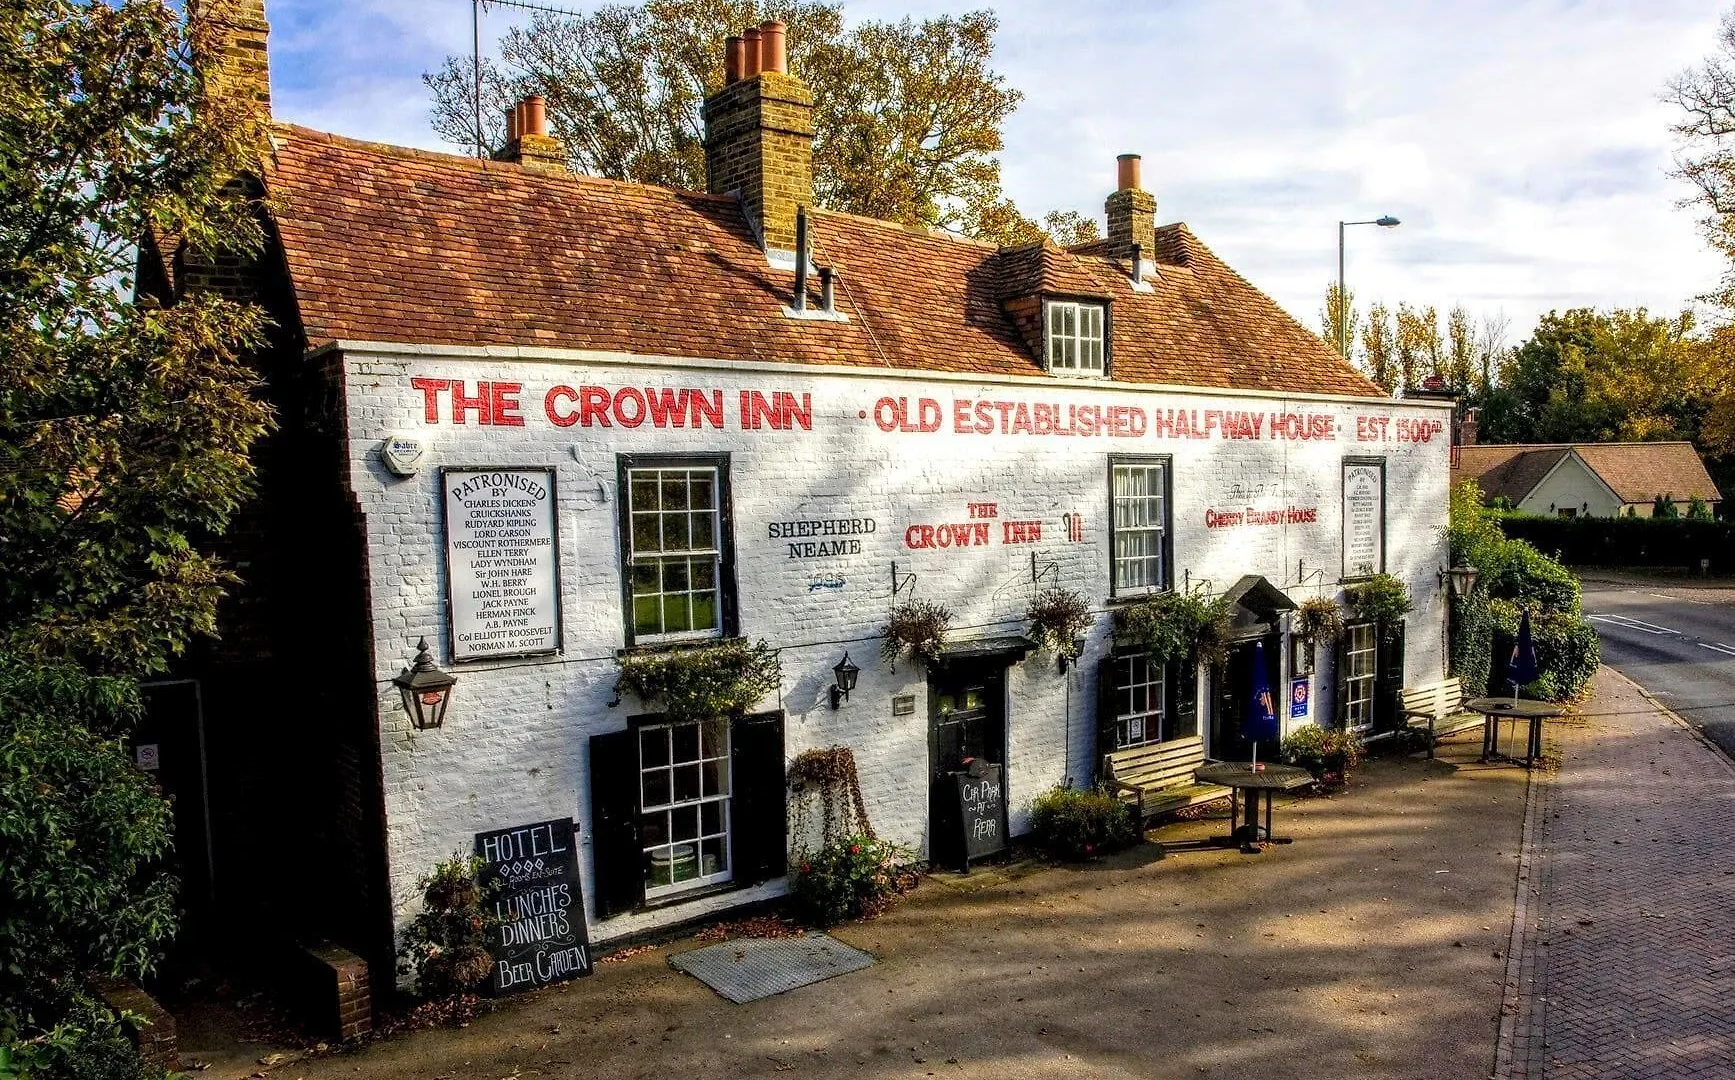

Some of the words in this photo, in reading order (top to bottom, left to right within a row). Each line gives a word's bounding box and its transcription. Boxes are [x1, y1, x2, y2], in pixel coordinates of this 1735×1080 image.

[411, 377, 526, 427] THE
[544, 385, 724, 429] CROWN
[740, 390, 812, 430] INN
[874, 396, 943, 433] OLD
[953, 399, 1148, 437] ESTABLISHED
[1156, 408, 1265, 440] HALFWAY
[1270, 412, 1336, 441] HOUSE
[1356, 416, 1391, 442] EST.
[452, 472, 547, 501] PATRONISED
[491, 488, 508, 497] BY
[464, 500, 500, 508] CHARLES
[502, 500, 536, 508] DICKENS
[470, 510, 532, 518] CRUICKSHANKS
[967, 502, 998, 519] THE
[465, 520, 505, 528] RUDYARD
[506, 519, 537, 527] KIPLING
[767, 518, 877, 538] SHEPHERD
[474, 530, 496, 538] LORD
[498, 529, 531, 538] CARSON
[904, 522, 990, 550] CROWN
[1002, 520, 1042, 545] INN
[453, 540, 496, 549] VISCOUNT
[498, 538, 551, 547] ROTHERMERE
[788, 539, 862, 559] NEAME
[477, 550, 502, 558] ELLEN
[504, 549, 529, 557] TERRY
[470, 560, 494, 568] LADY
[495, 558, 537, 567] WYNDHAM
[487, 570, 509, 579] JOHN
[511, 568, 532, 576] HARE
[481, 580, 501, 588] W.H.
[472, 590, 501, 599] LIONEL
[503, 588, 537, 596] BROUGH
[482, 600, 503, 610] JACK
[504, 598, 529, 606] PAYNE
[476, 610, 511, 619] HERMAN
[513, 608, 537, 616] FINCK
[485, 621, 501, 629] A.B.
[503, 619, 528, 627] PAYNE
[458, 632, 472, 641] Col
[474, 630, 507, 640] ELLIOTT
[508, 627, 553, 637] ROOSEVELT
[469, 642, 505, 652] NORMAN
[519, 638, 544, 648] SCOTT
[977, 802, 986, 813] AT
[483, 824, 567, 863] HOTEL
[496, 883, 572, 922] LUNCHES
[502, 908, 570, 947] DINNERS
